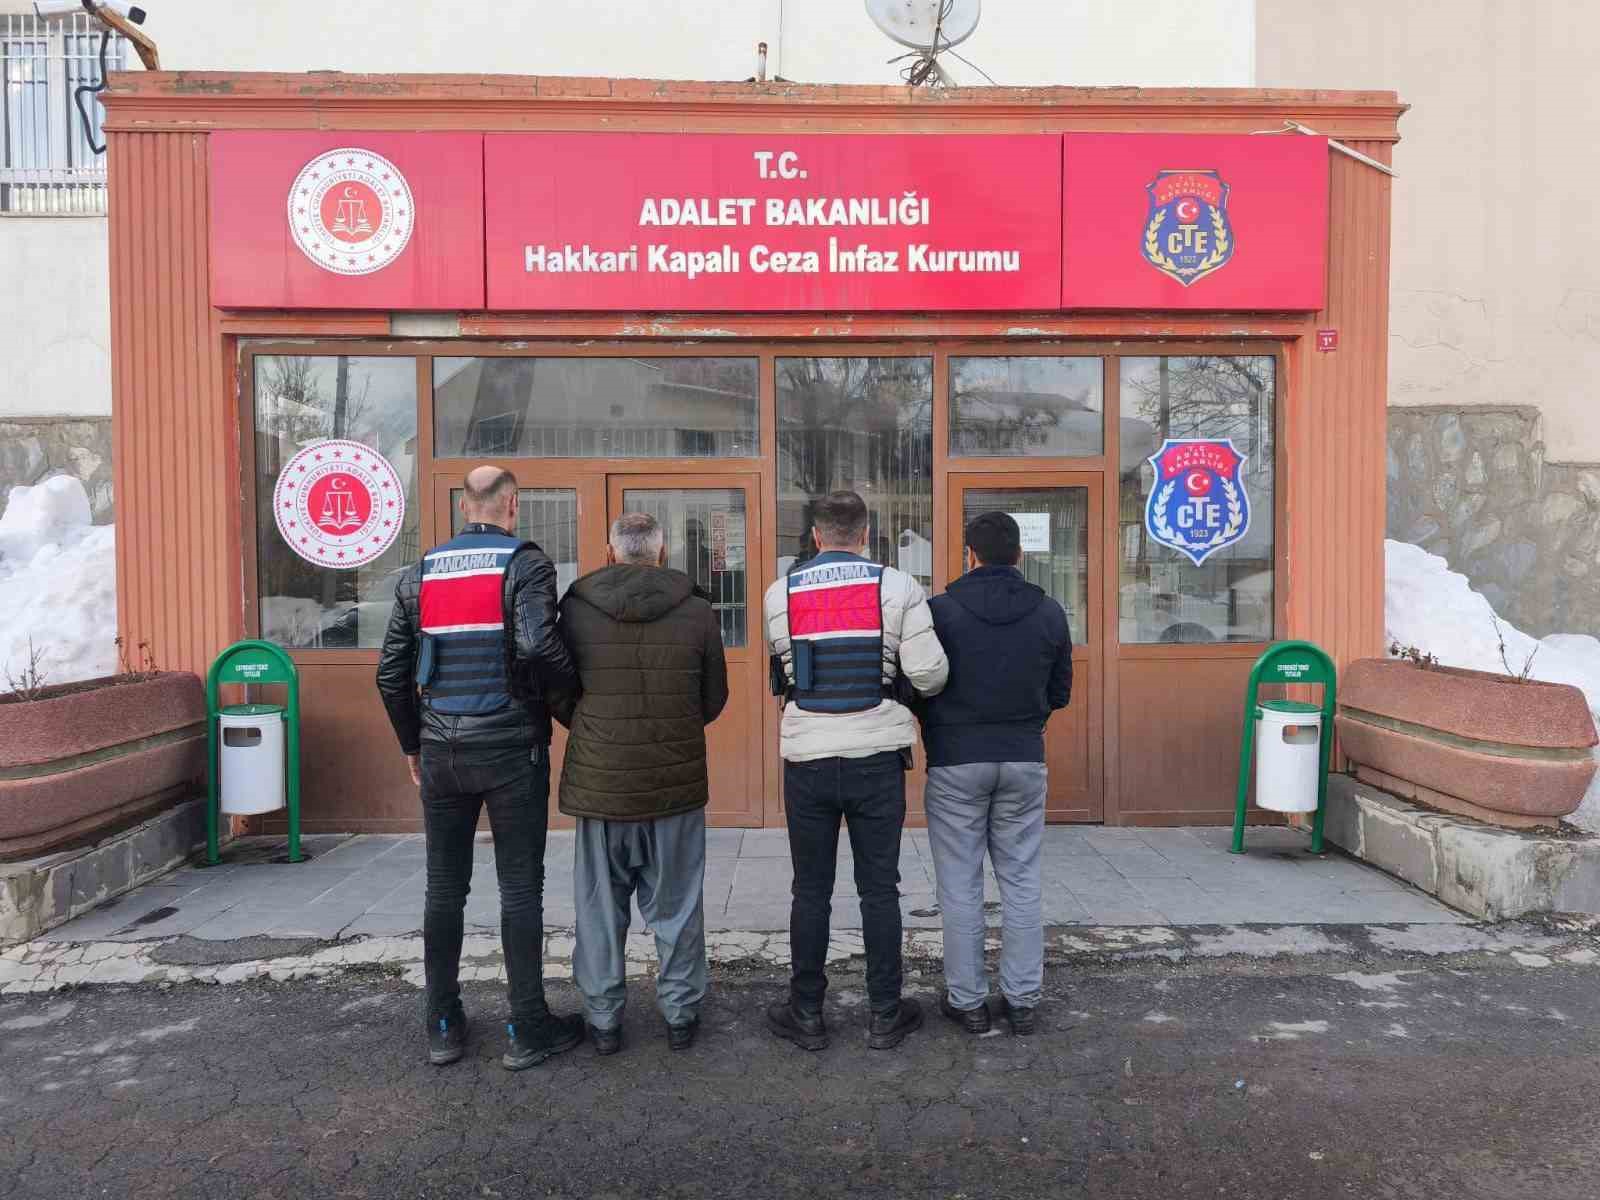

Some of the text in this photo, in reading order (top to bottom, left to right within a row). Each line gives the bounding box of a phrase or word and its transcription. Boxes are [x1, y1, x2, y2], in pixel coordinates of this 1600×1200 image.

[753, 151, 808, 180] T.C.
[639, 191, 931, 226] ADALET BAKANLIĞI
[1167, 224, 1209, 254] CTE
[524, 236, 1021, 279] Hakkari Kapalı Ceza İnfaz Kurumu
[1177, 496, 1220, 528] CTE
[430, 553, 497, 573] JANDARMA
[800, 566, 870, 585] JANDARMA
